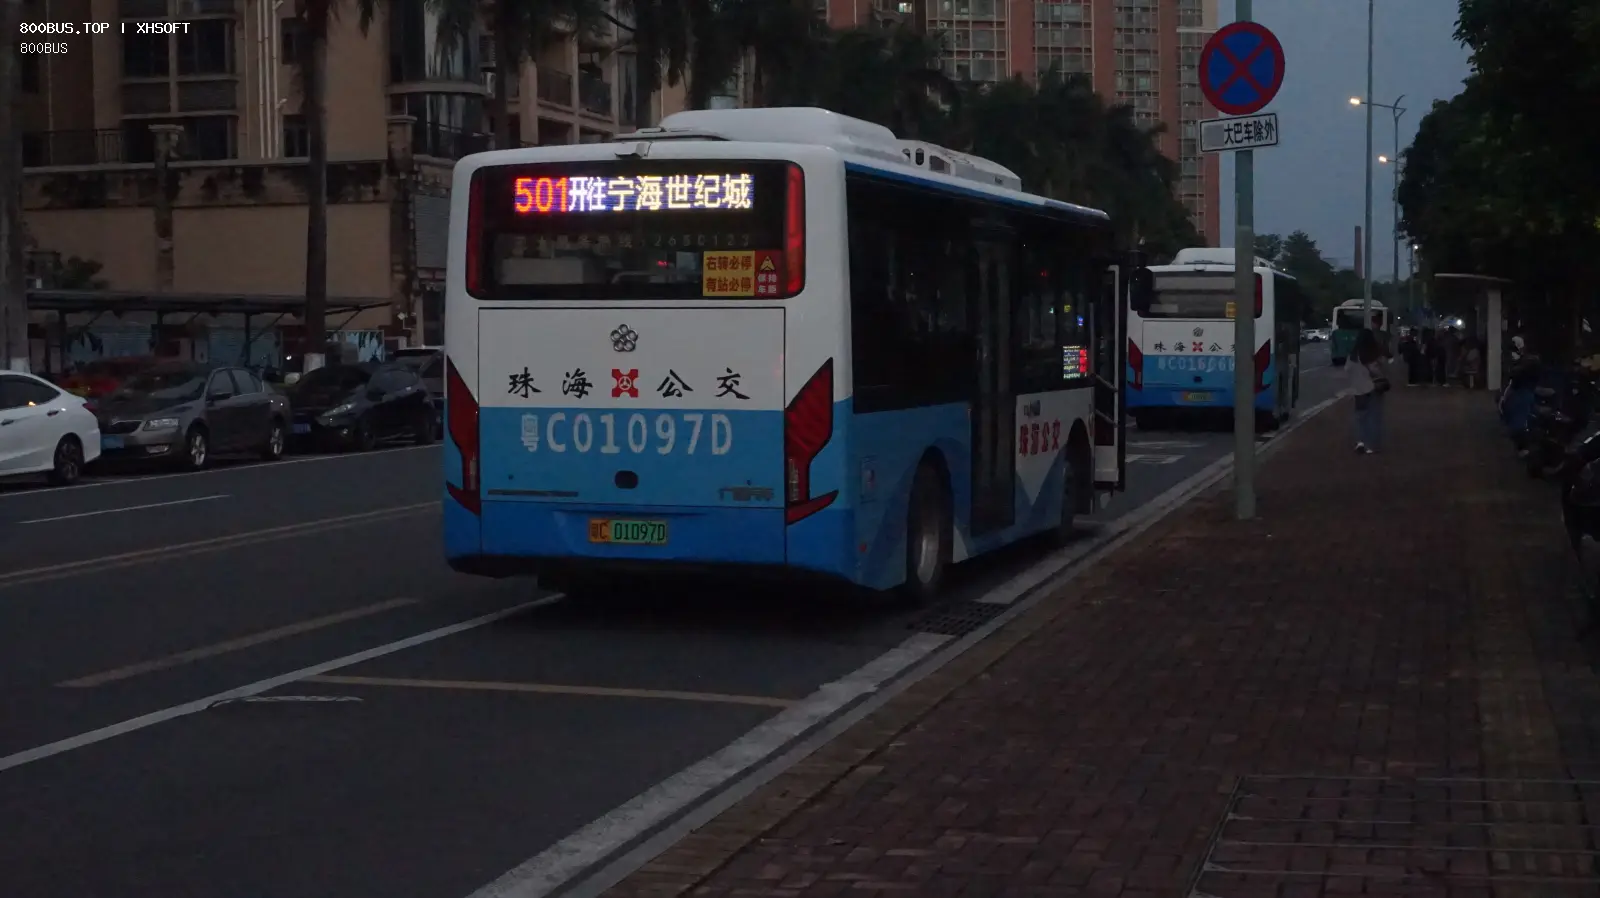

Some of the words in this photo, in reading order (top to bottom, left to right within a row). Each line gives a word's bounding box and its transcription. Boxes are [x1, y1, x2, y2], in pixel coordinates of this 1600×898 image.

[1223, 118, 1275, 145] 大巴车除外
[515, 177, 567, 212] 501
[568, 174, 751, 212] 开往宁海世纪城
[706, 255, 752, 270] 右转必停
[507, 367, 593, 399] 珠海
[656, 368, 751, 400] 公交
[520, 412, 733, 455] 粤C01097D
